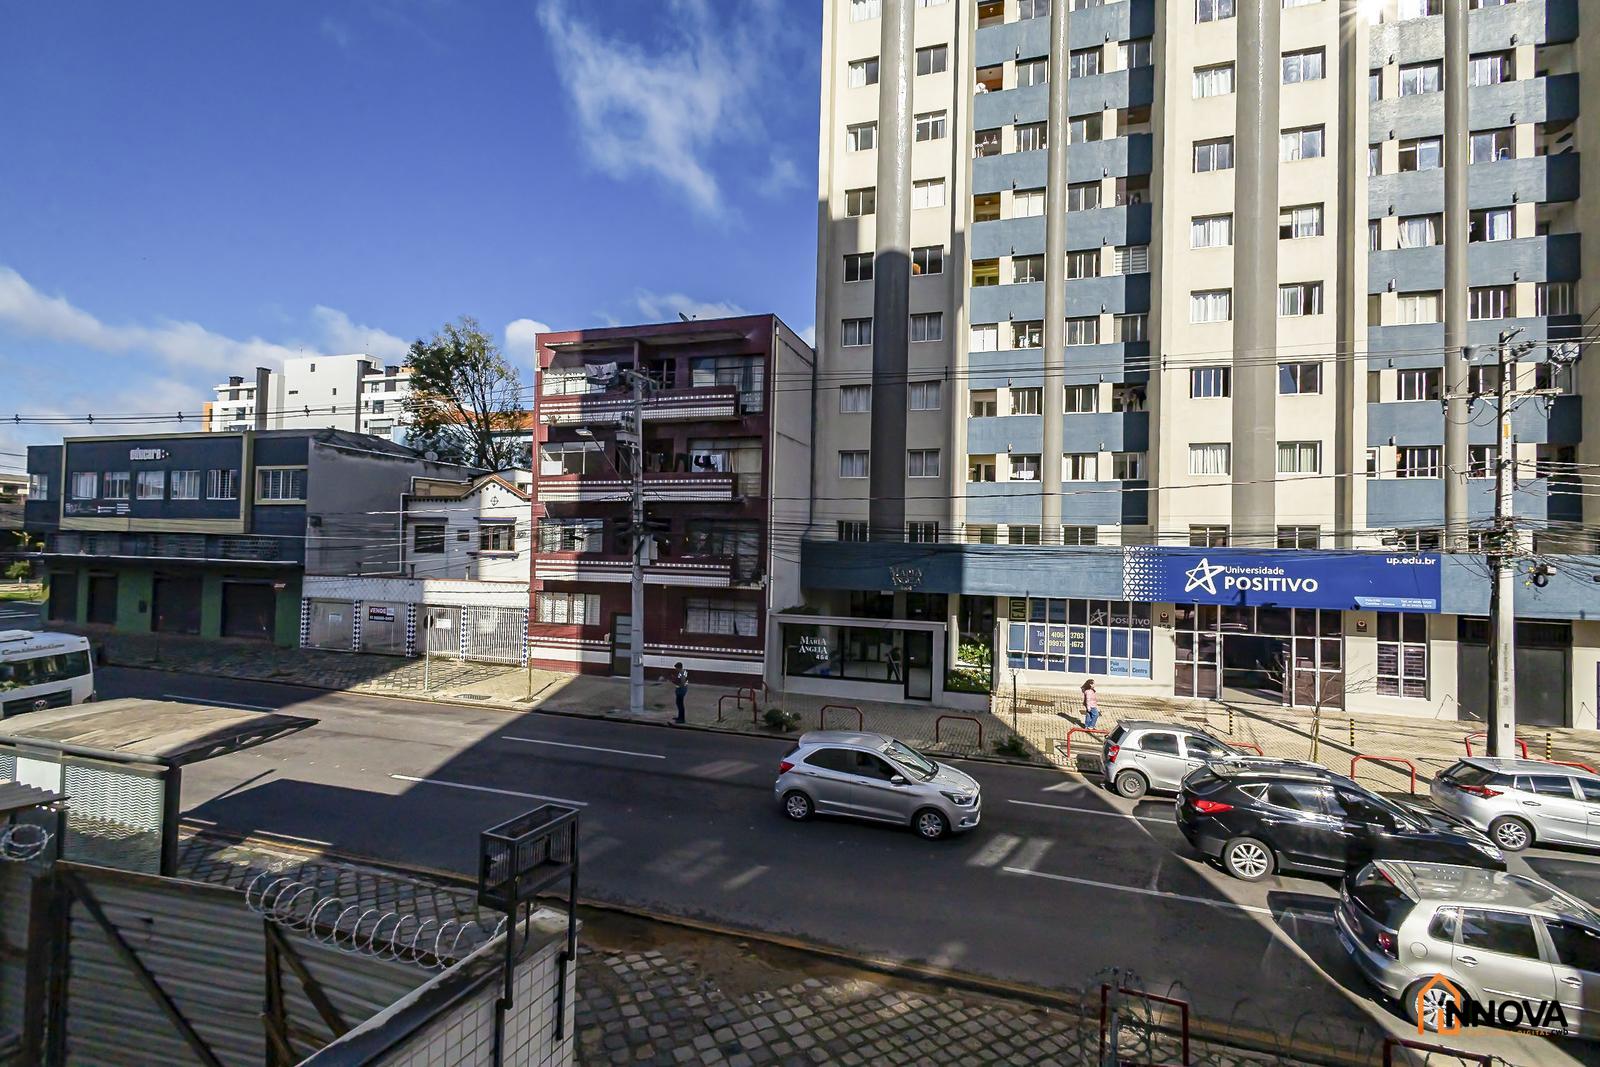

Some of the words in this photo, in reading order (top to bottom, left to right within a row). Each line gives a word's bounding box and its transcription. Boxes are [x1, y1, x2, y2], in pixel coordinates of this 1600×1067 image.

[1386, 557, 1436, 565] up.edu.br
[1225, 566, 1285, 575] Universidade
[1224, 576, 1319, 593] POSITIVO
